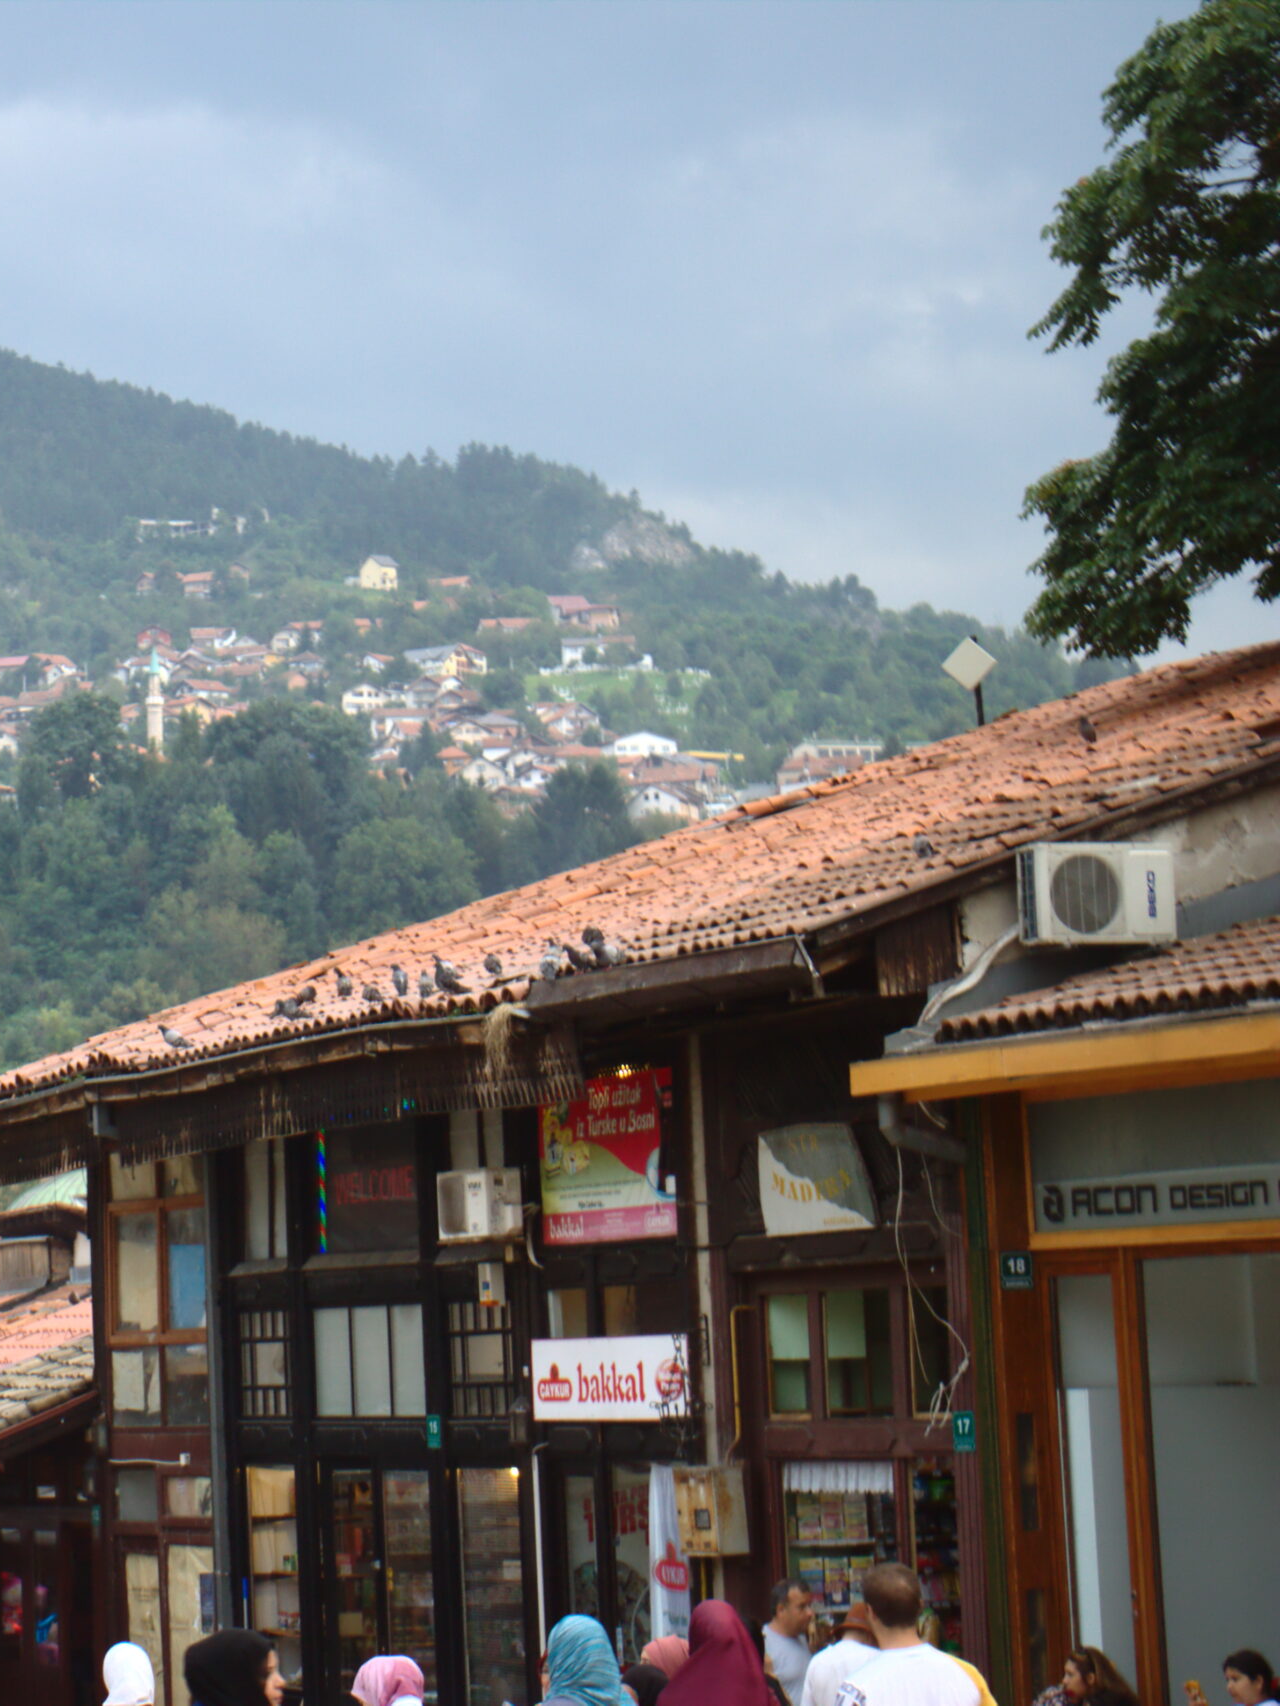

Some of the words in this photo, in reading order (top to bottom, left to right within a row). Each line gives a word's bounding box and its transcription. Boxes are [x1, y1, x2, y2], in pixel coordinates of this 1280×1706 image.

[577, 1117, 584, 1138] iz
[587, 1112, 617, 1137] Turske
[620, 1116, 626, 1133] u
[627, 1106, 655, 1133] Bosni
[332, 1165, 415, 1205] WELCOME
[1071, 1183, 1158, 1216] ACON
[1169, 1180, 1268, 1210] DESIGN
[549, 1214, 584, 1239] bakkal
[1007, 1257, 1026, 1274] 18
[577, 1360, 646, 1403] bakkal
[956, 1417, 971, 1435] 17
